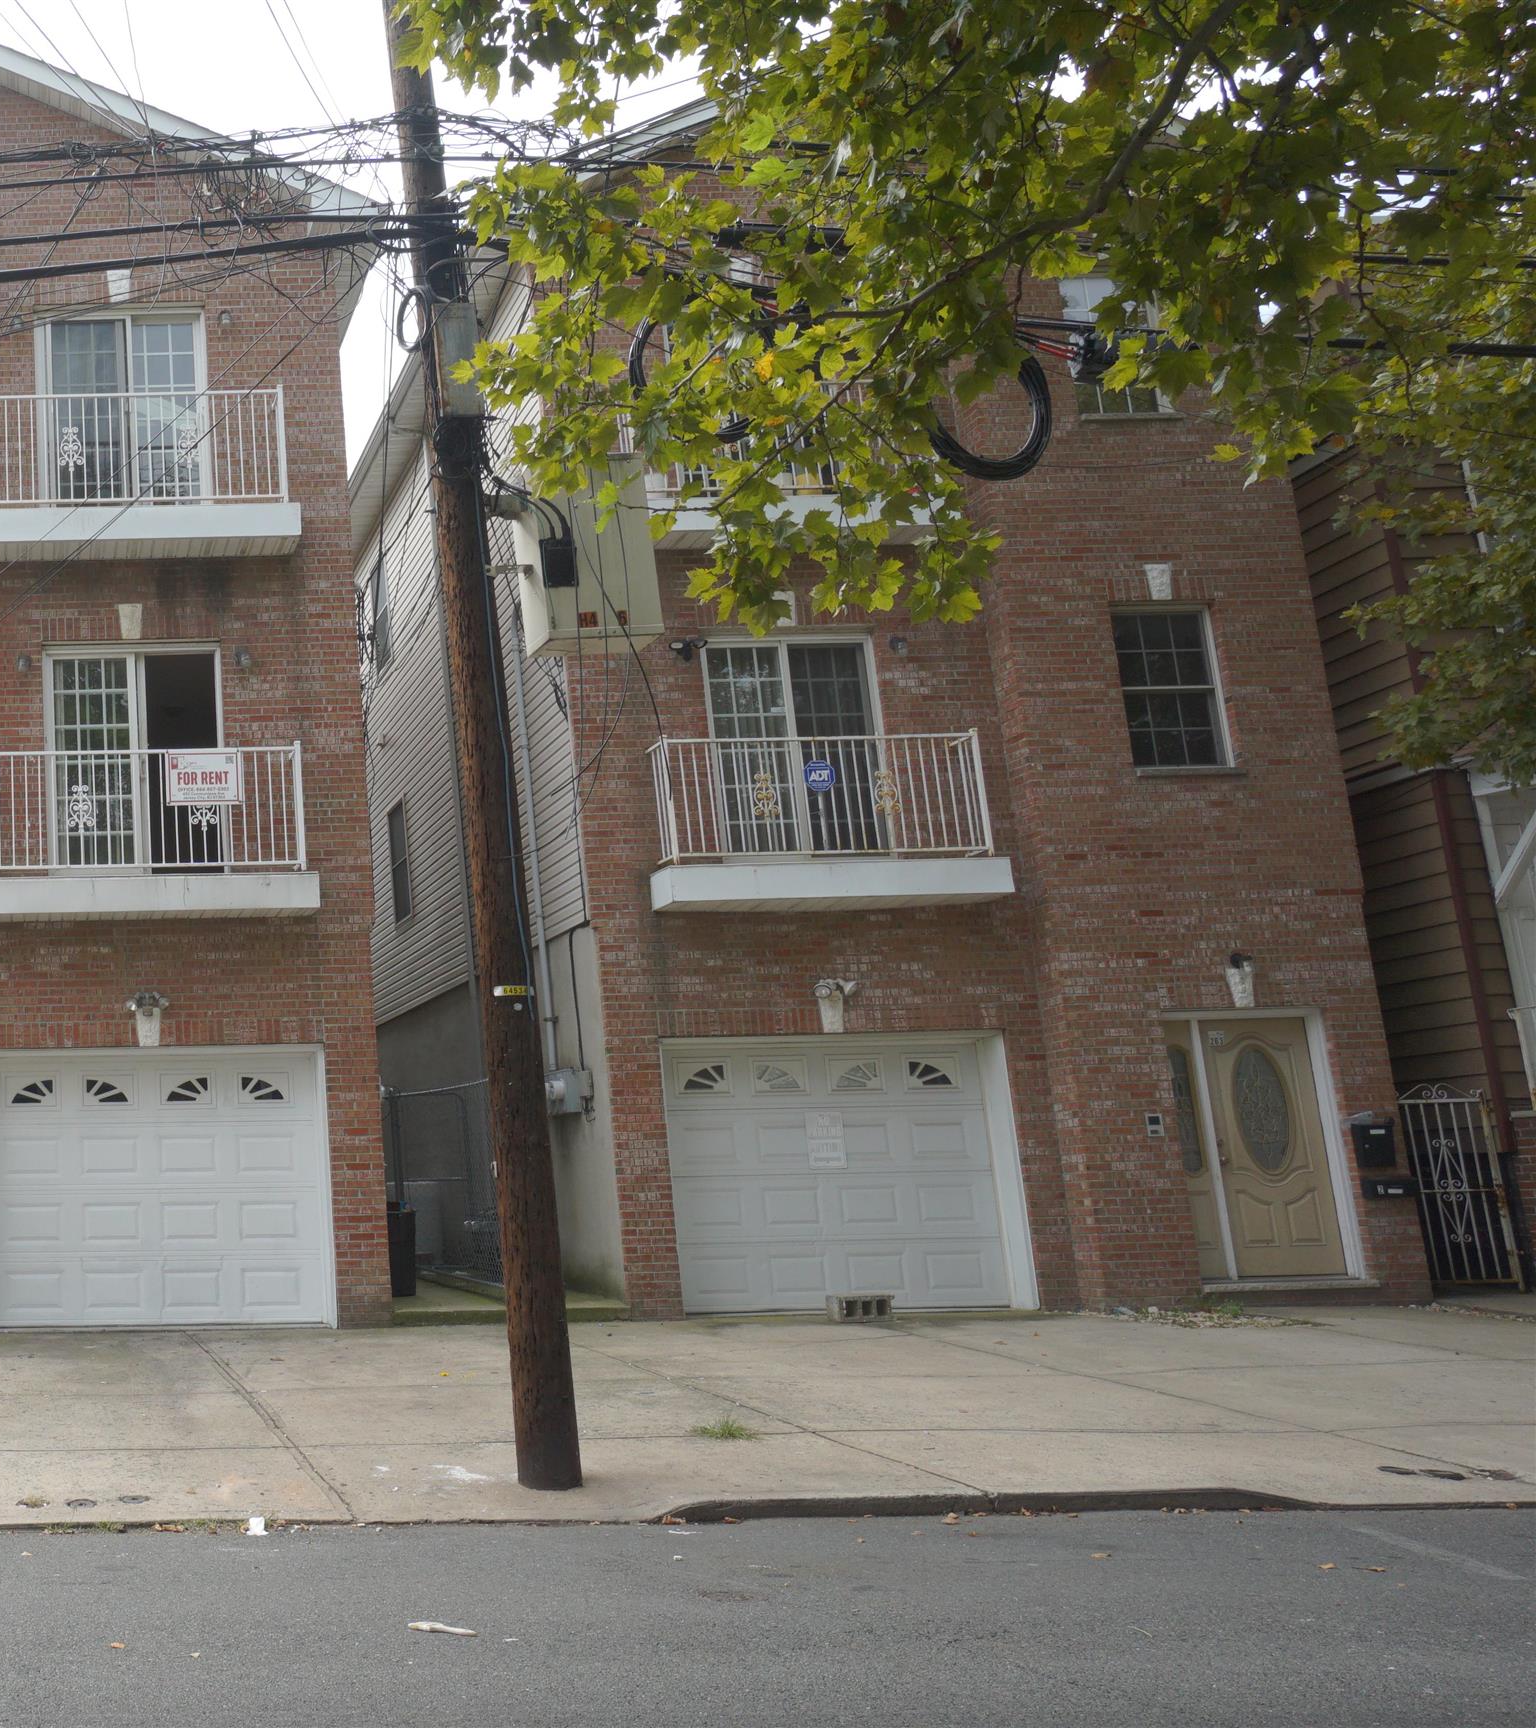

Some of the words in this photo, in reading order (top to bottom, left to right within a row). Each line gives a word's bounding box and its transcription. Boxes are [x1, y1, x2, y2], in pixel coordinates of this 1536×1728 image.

[177, 771, 198, 785] FOR
[201, 771, 229, 785] RENT
[809, 769, 829, 782] ADT
